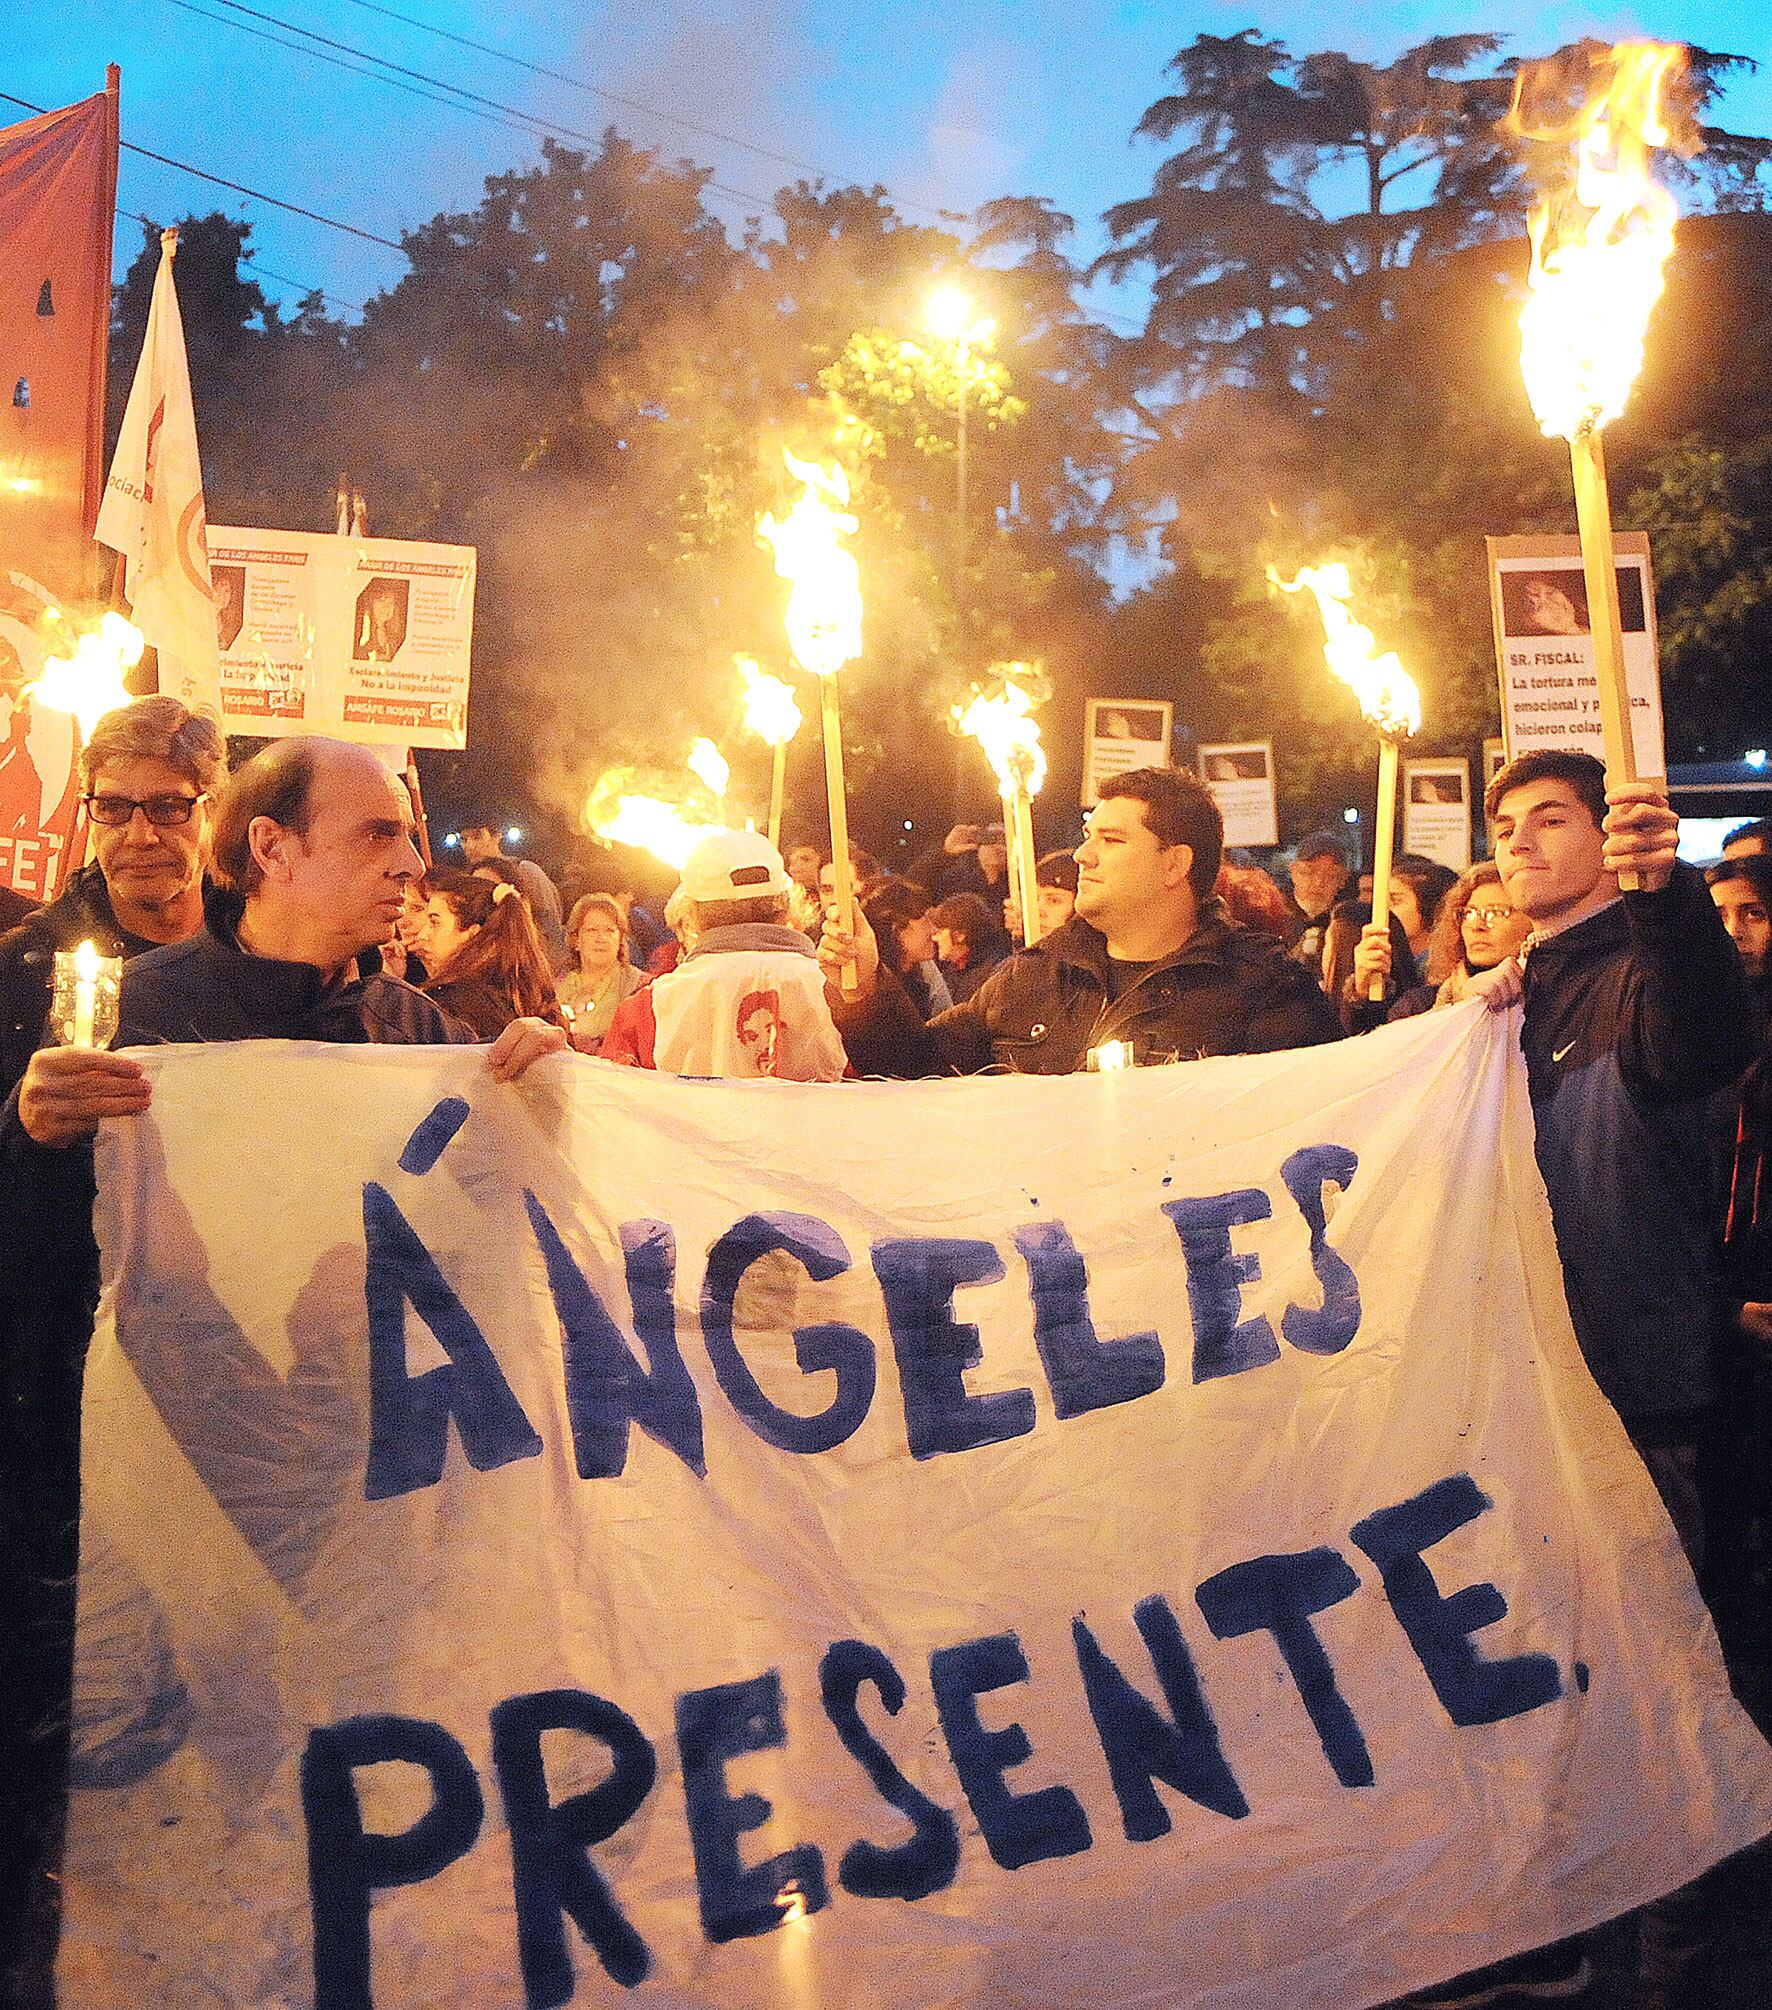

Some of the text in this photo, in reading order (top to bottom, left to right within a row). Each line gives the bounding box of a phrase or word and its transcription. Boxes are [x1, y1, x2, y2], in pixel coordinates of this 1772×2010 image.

[1510, 652, 1584, 666] SR. FISCAL:
[360, 679, 376, 689] No
[1512, 677, 1528, 689] La
[1531, 677, 1574, 689] tortura
[1514, 697, 1578, 713] emocional
[1581, 701, 1589, 714] y
[1515, 723, 1566, 736] hicieron
[364, 1099, 1360, 1501] ÁNGELES
